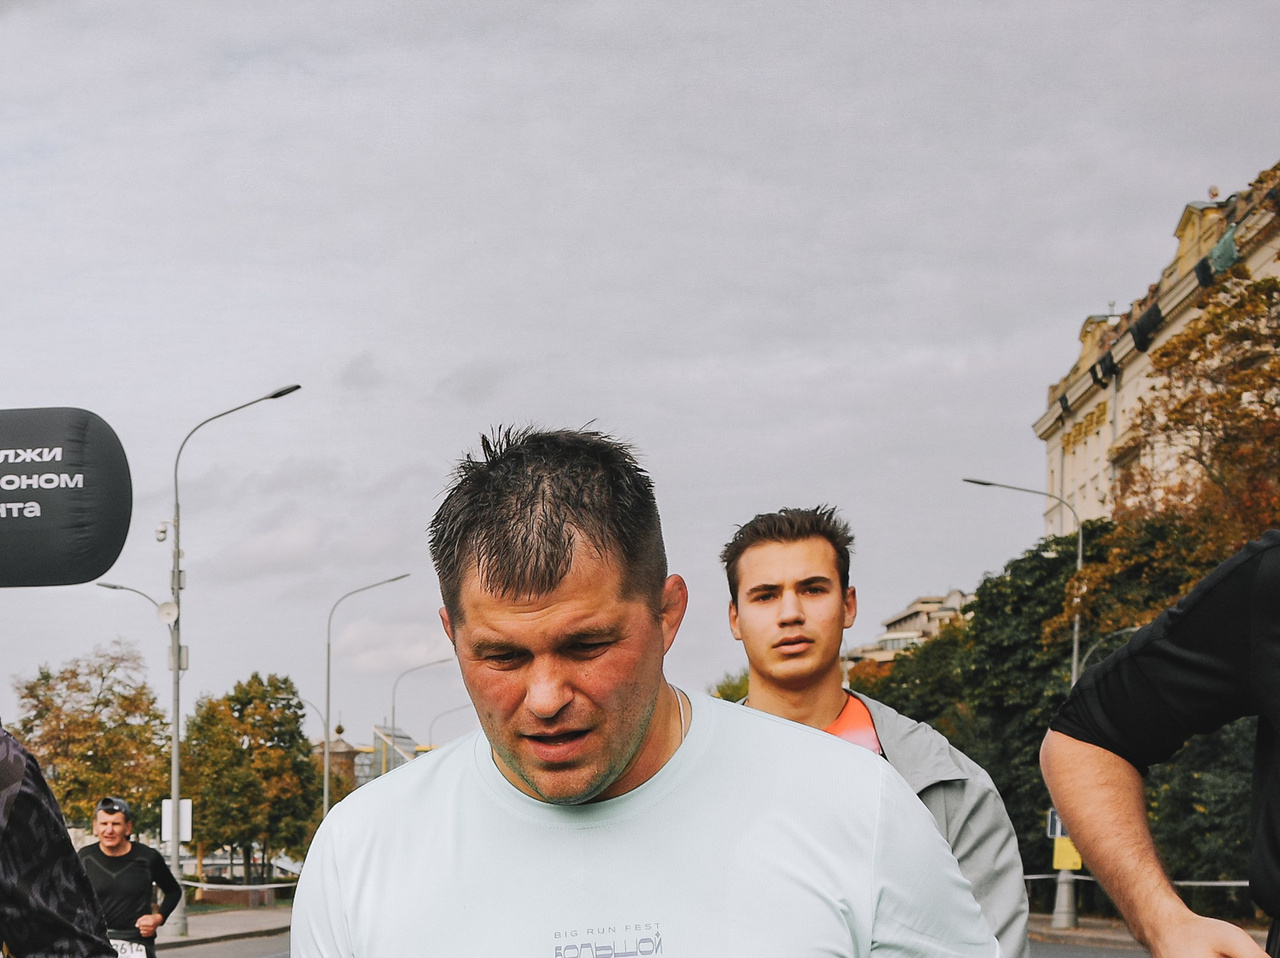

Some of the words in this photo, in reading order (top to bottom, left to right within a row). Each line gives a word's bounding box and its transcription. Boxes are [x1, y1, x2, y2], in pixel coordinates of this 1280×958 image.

[554, 930, 578, 939] BIG
[586, 926, 616, 935] RUN
[625, 922, 660, 931] FEST
